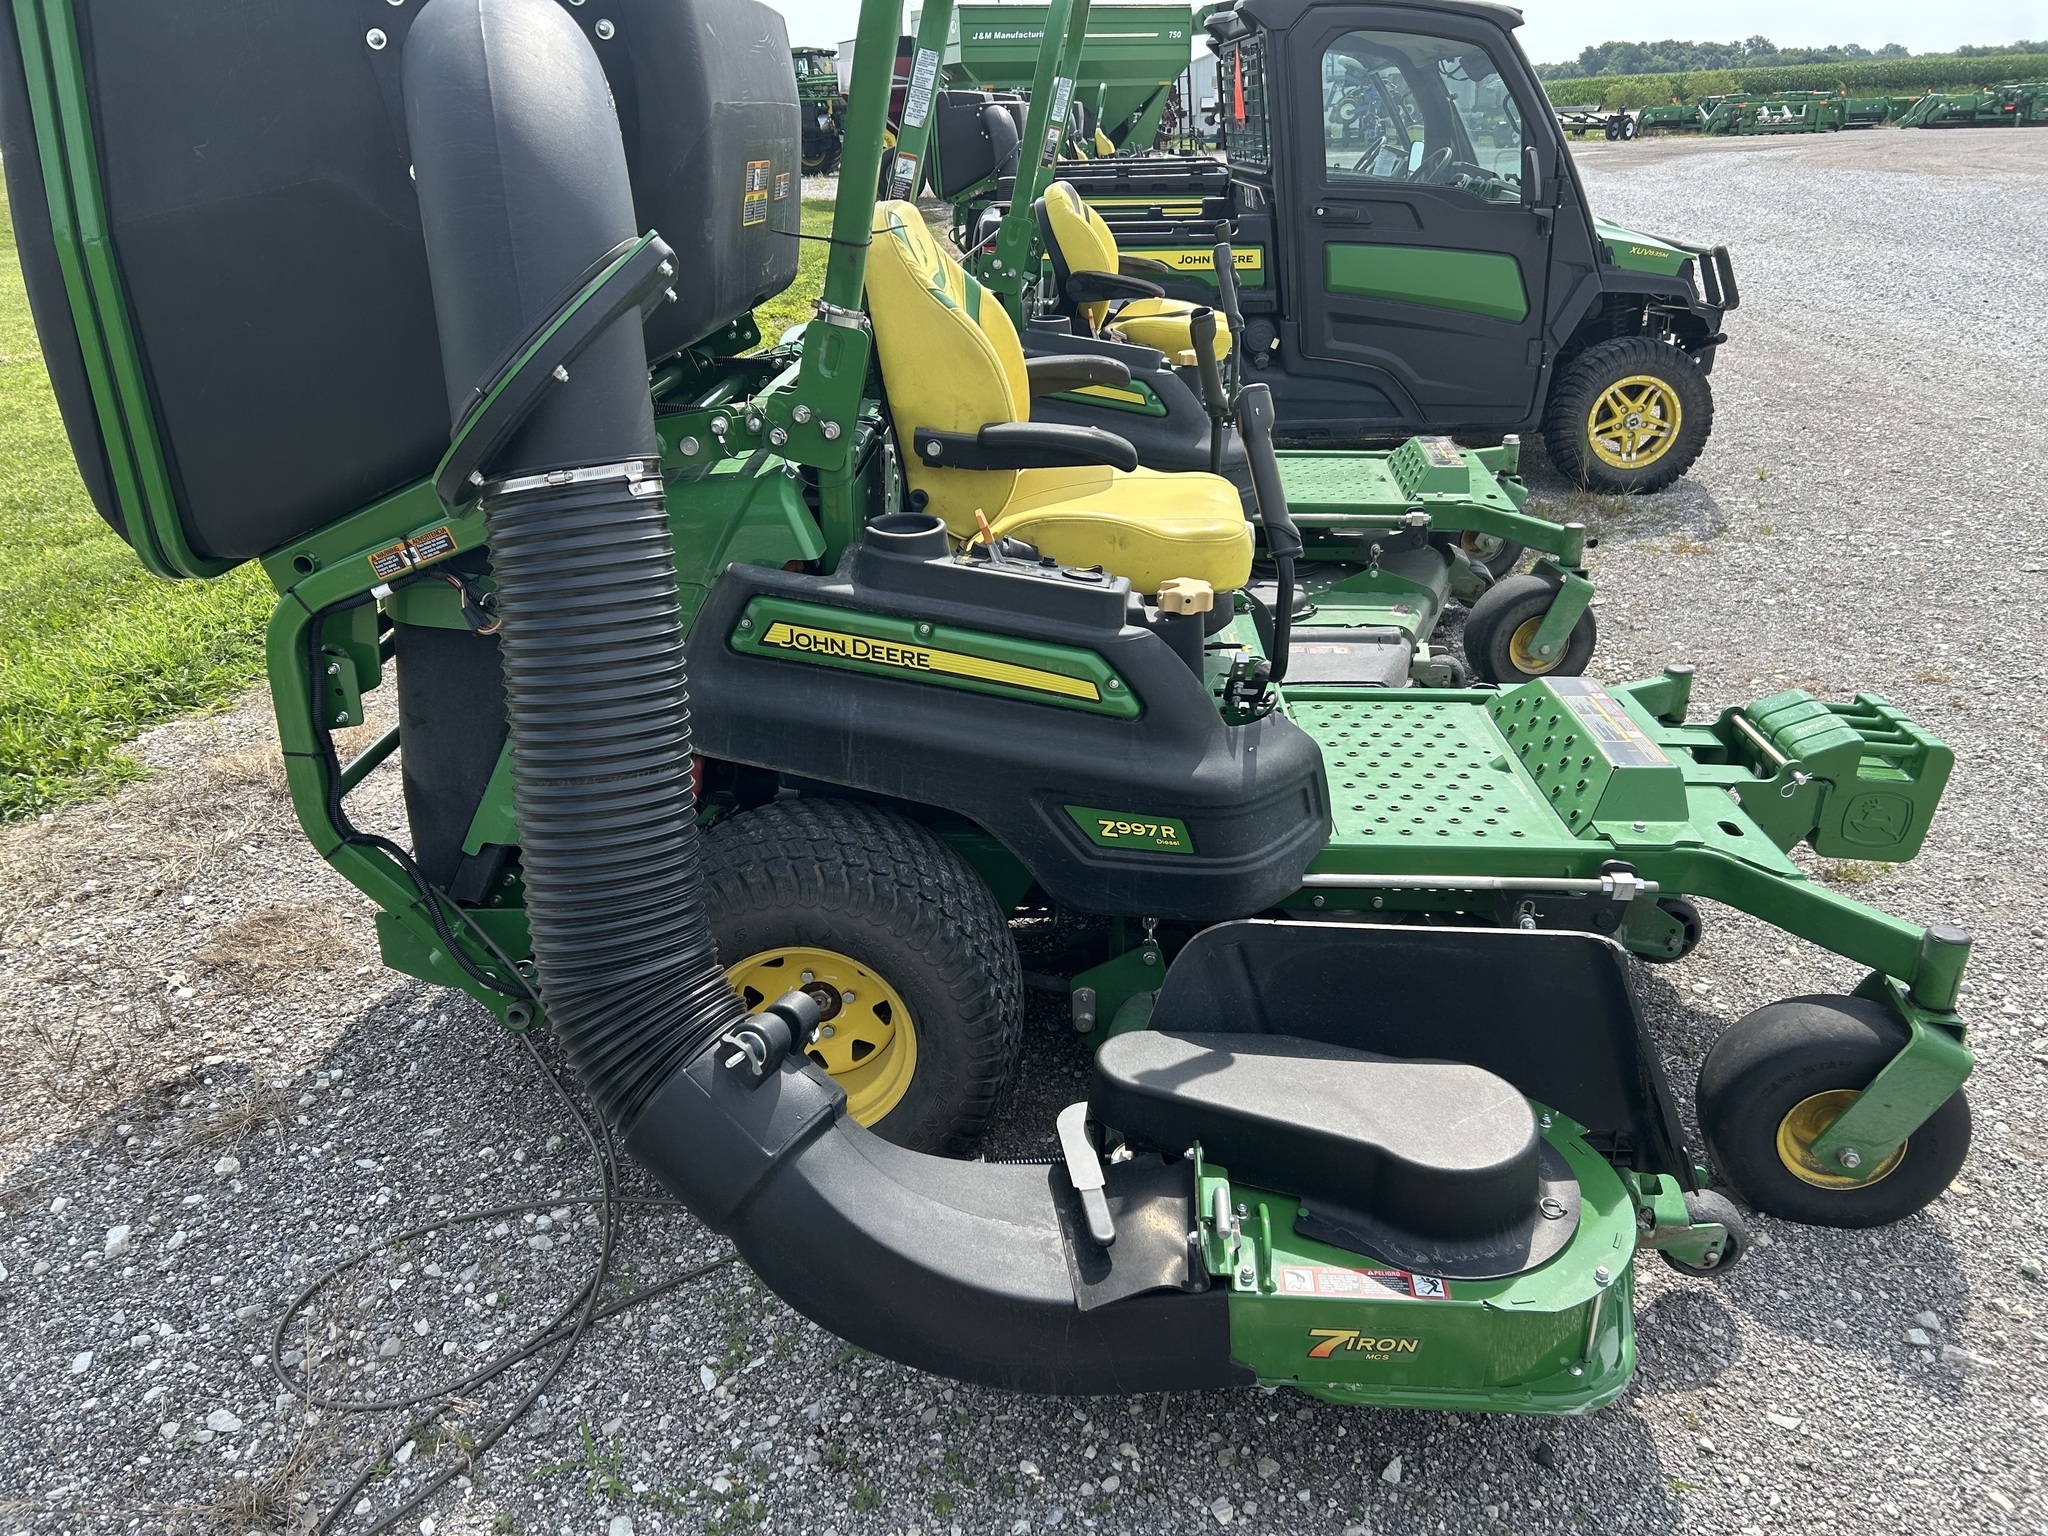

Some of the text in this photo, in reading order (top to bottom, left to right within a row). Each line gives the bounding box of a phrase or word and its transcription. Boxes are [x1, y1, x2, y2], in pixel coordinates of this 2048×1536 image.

[972, 31, 992, 40] J&M
[1168, 31, 1182, 39] 750
[1177, 254, 1211, 264] JOHN
[412, 527, 447, 545] ADVERTENCIA
[375, 546, 400, 559] WARNING
[781, 628, 931, 669] JOHN DEERE
[1155, 838, 1180, 846] Diesel
[907, 1070, 957, 1150] KEND
[1307, 1328, 1420, 1358] 7 IRON
